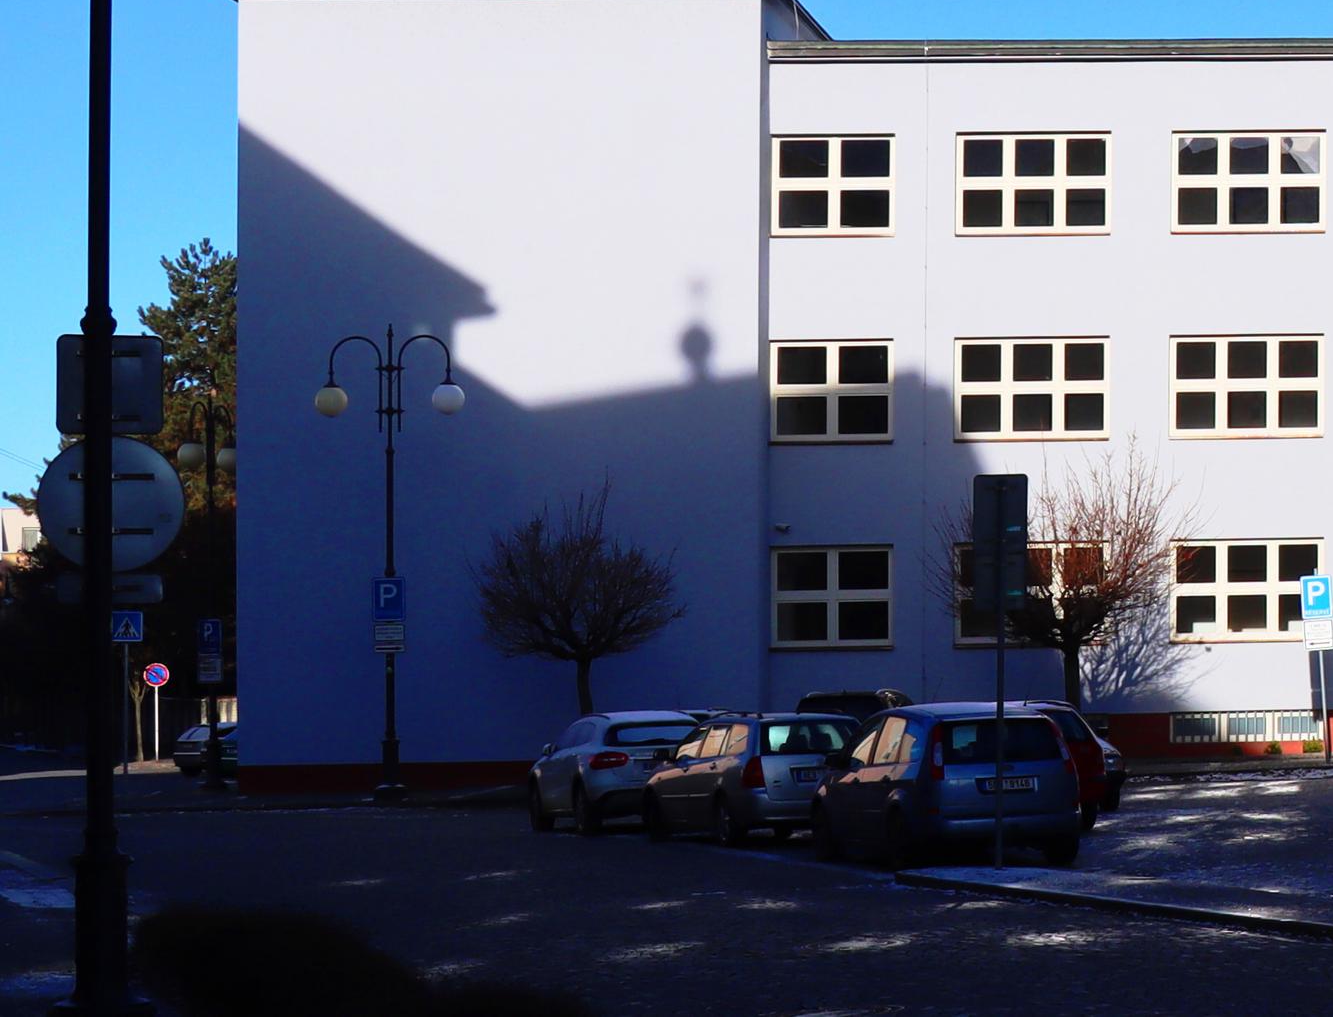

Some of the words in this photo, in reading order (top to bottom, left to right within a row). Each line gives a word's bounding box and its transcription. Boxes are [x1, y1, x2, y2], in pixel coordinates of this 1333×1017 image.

[379, 583, 398, 608] P
[1306, 580, 1326, 607] P
[203, 622, 213, 643] P
